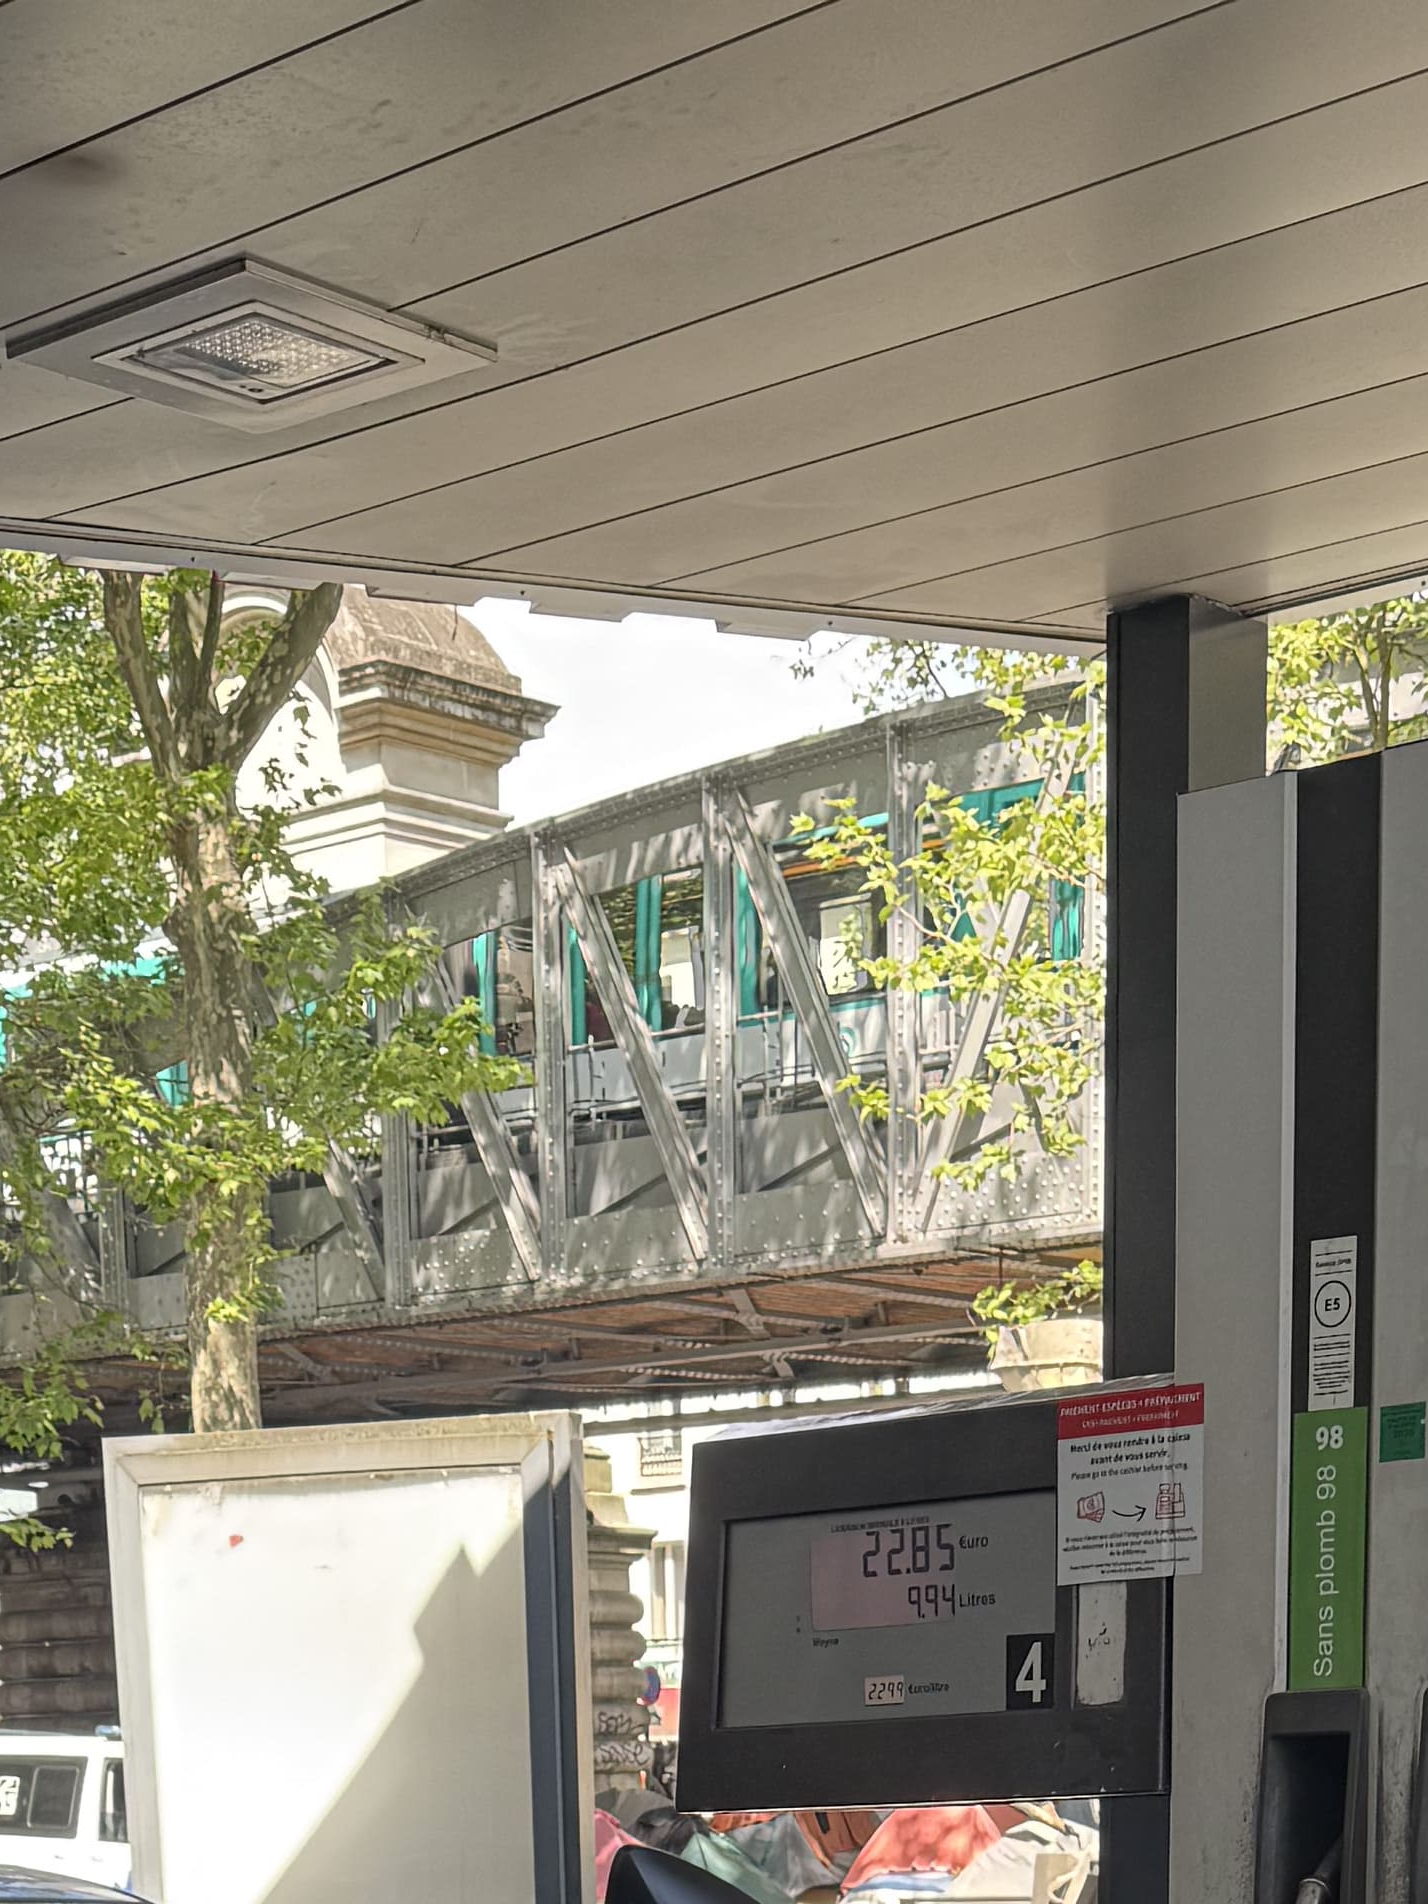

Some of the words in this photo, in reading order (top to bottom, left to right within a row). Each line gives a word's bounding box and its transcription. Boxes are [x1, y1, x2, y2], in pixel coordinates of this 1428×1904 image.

[1324, 1297, 1341, 1311] E5
[1315, 1425, 1344, 1451] 98
[1316, 1464, 1337, 1500] 98
[863, 1524, 955, 1578] 22.85
[1315, 1509, 1340, 1596] plomb
[908, 1584, 955, 1618] 9.94
[958, 1590, 996, 1608] Litres
[1314, 1606, 1334, 1677] Sans
[1015, 1641, 1046, 1702] 4
